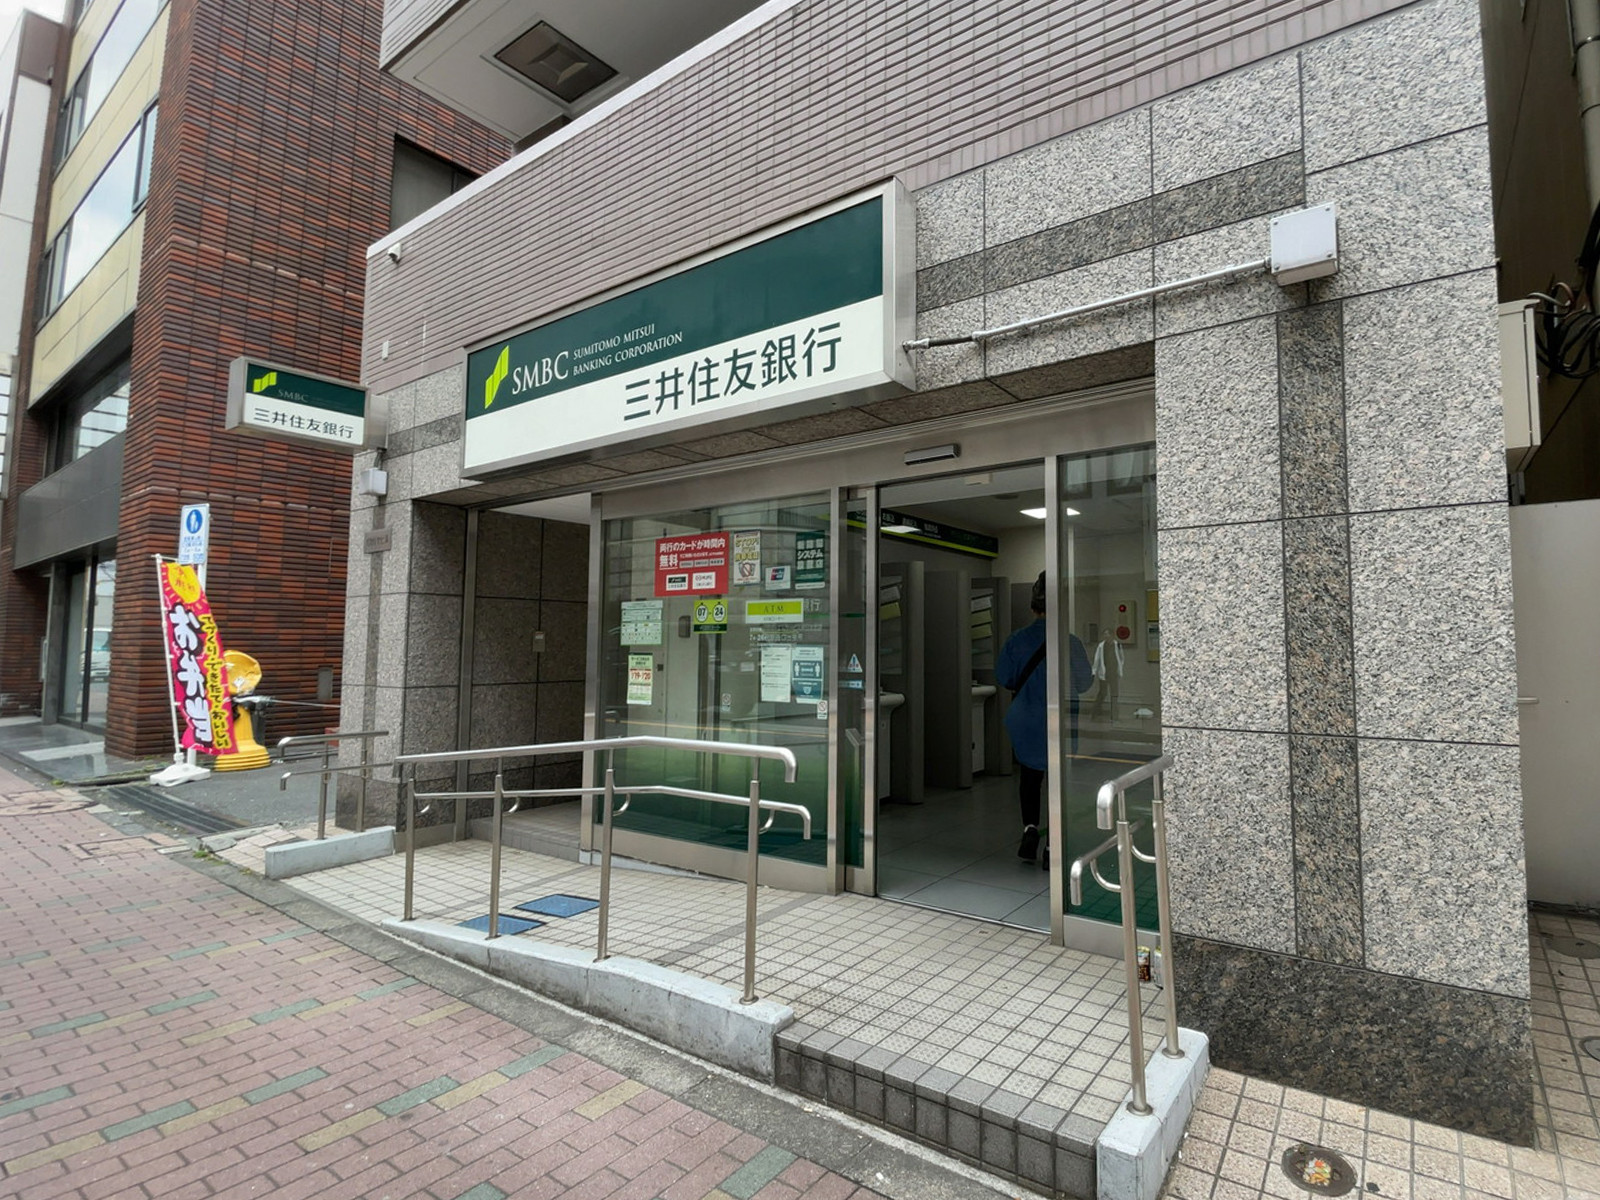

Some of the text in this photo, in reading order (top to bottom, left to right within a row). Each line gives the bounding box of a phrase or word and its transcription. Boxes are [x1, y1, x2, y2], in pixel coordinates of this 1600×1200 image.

[573, 322, 656, 361] SUMITOMO MITSUI
[573, 331, 683, 377] BANKING CORPORATION
[512, 351, 570, 396] SMBC
[623, 322, 842, 422] 三井住友銀行
[278, 389, 309, 404] SMBC
[253, 407, 354, 439] 三井住友銀行
[659, 553, 678, 568] 無料
[797, 549, 824, 560] システム
[697, 607, 724, 617] 07 24
[763, 604, 784, 614] ATM
[169, 604, 213, 742] お弁当
